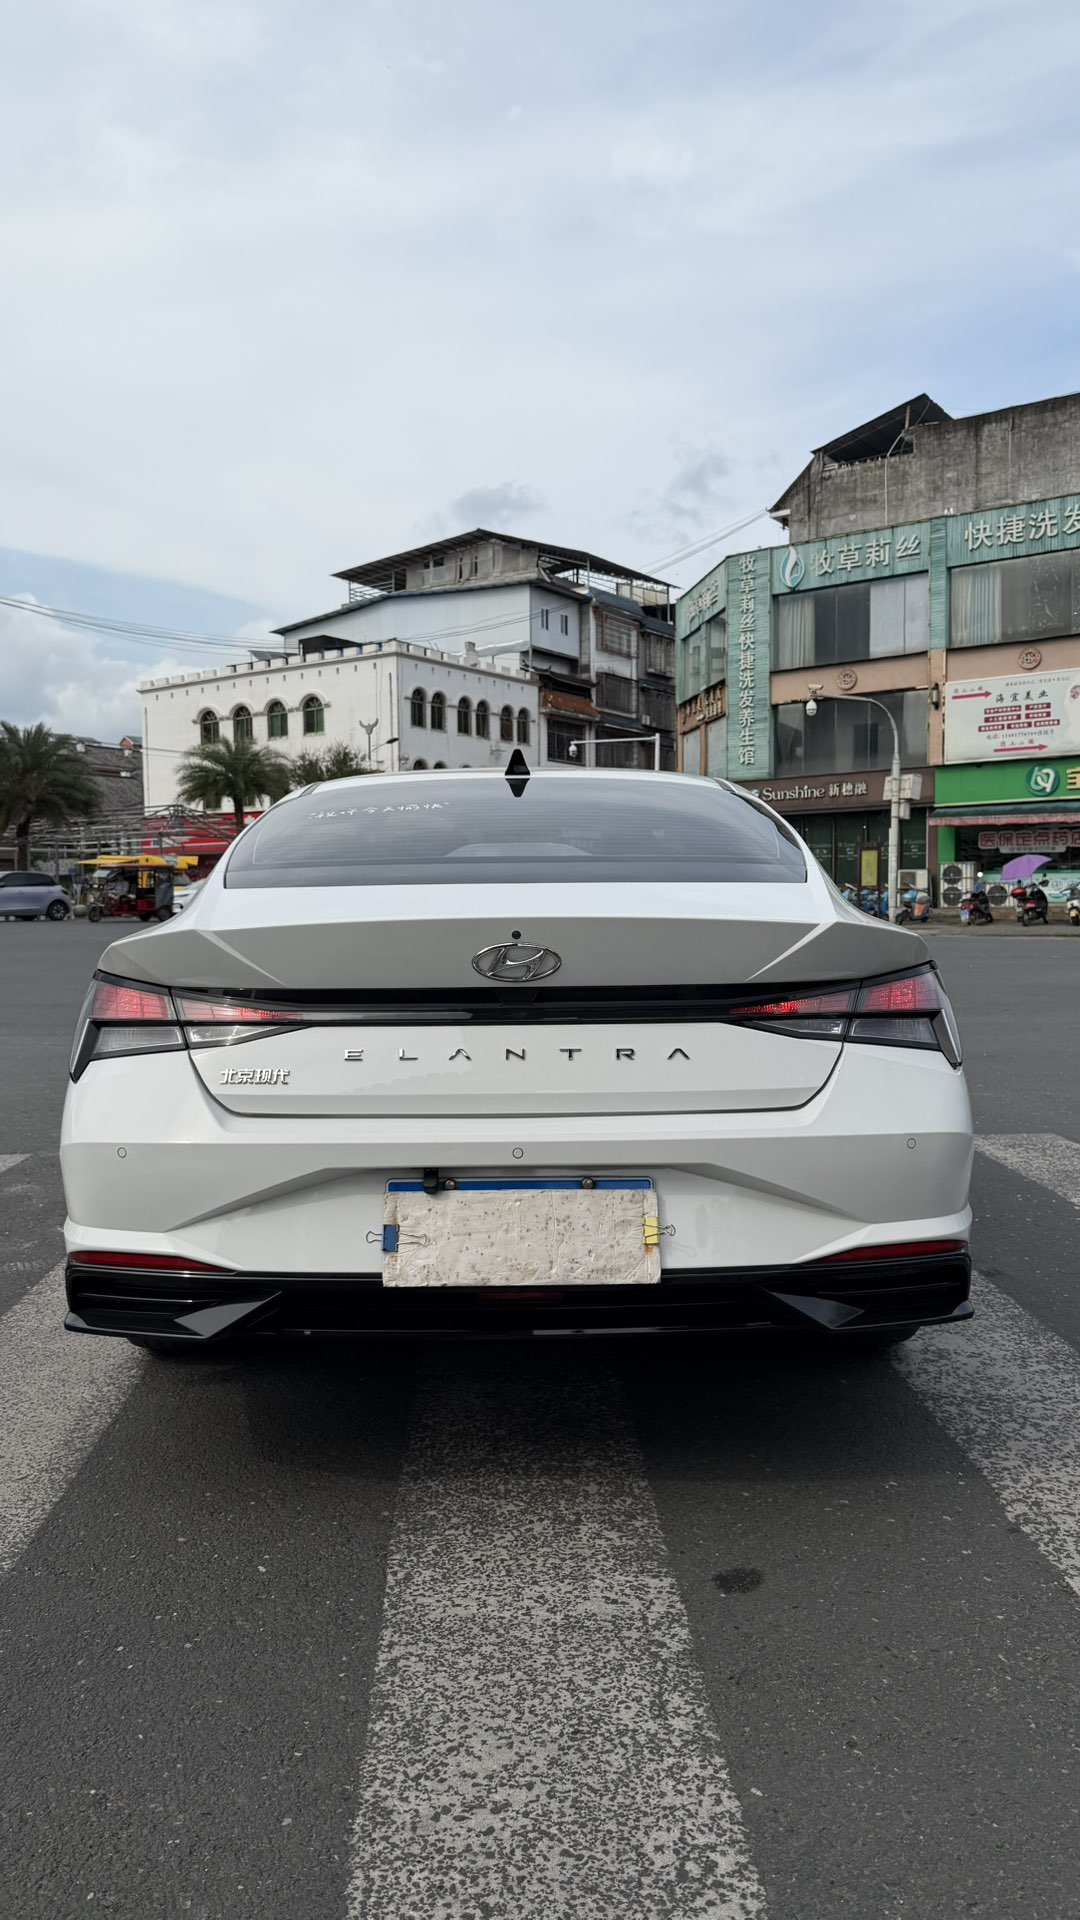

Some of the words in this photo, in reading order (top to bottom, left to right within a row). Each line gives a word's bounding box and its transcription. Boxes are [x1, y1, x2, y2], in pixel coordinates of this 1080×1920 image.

[964, 504, 1080, 551] 快捷洗发
[810, 534, 922, 577] 牧草莉丝
[738, 554, 756, 765] 牧草莉丝快捷洗发养生馆
[762, 785, 825, 801] Sunshine
[344, 1048, 691, 1062] ELANTRA
[218, 1068, 291, 1085] 北京现代
